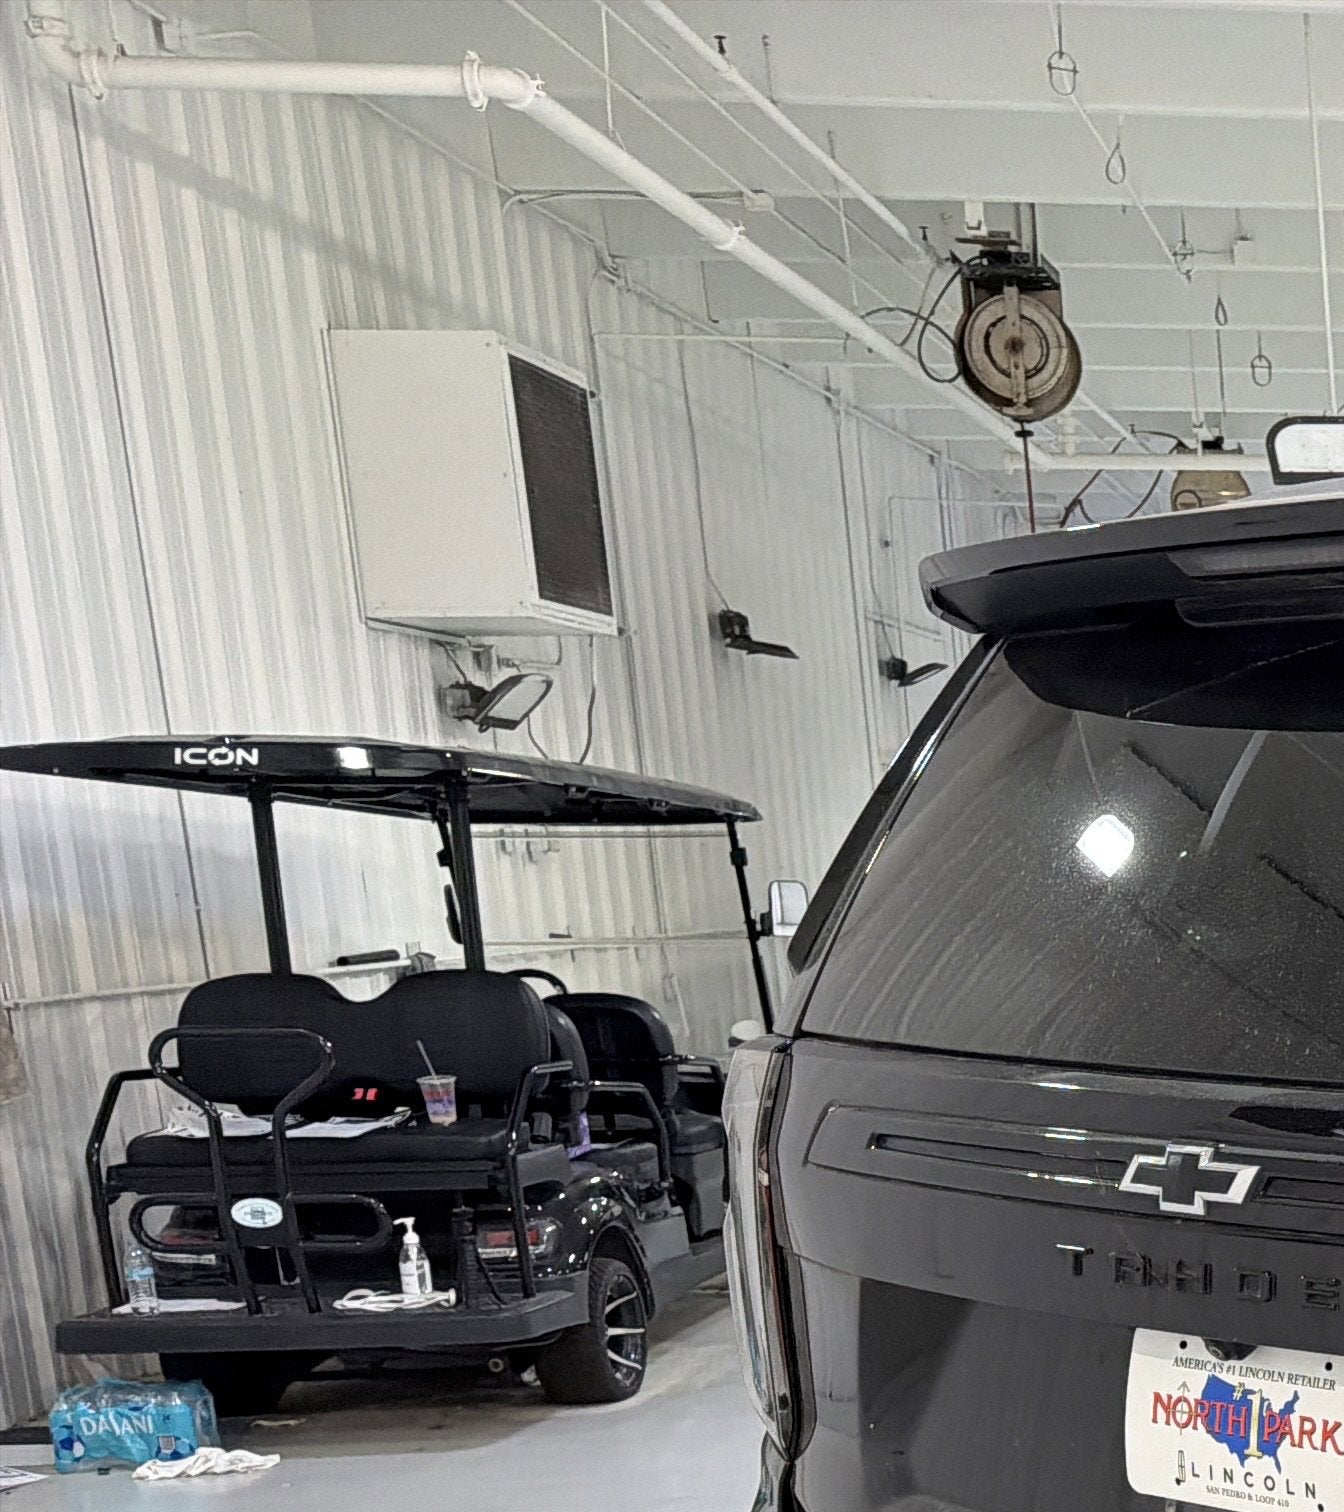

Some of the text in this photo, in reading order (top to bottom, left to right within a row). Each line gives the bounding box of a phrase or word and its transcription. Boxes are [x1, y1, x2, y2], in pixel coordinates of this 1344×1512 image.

[174, 745, 259, 766] ICON
[1056, 1243, 1342, 1312] TAHOE
[1171, 1356, 1337, 1392] AMERICA'S #1 LINCOLN RETAILER
[1151, 1391, 1249, 1438] NORTH
[1191, 1461, 1316, 1500] LINCOLN
[1206, 1485, 1221, 1495] SAN
[1221, 1488, 1247, 1500] PEDRO
[1255, 1494, 1276, 1506] LOOP
[1277, 1499, 1290, 1508] 410
